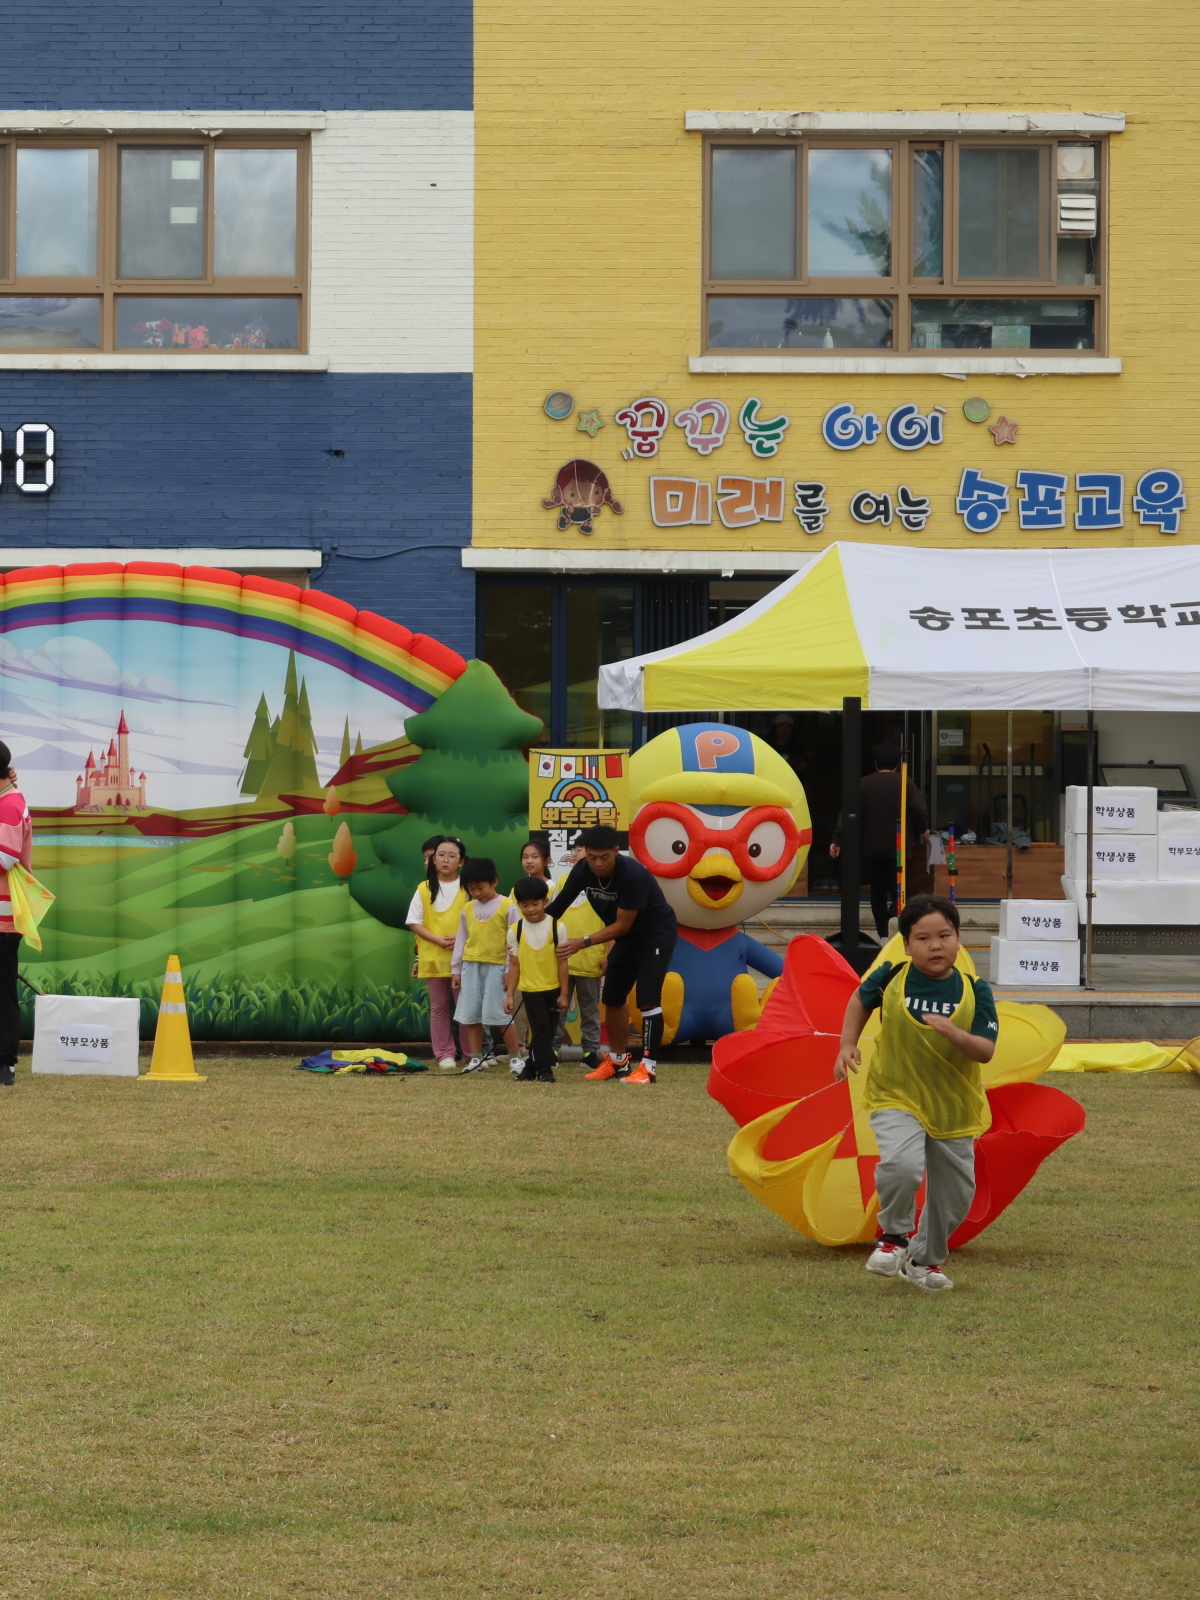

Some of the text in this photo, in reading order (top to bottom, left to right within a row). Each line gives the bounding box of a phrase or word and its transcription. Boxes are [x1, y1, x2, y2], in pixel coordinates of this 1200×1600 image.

[615, 397, 945, 457] 꿈꾸는 아이
[650, 467, 1187, 534] 미래를 여는 송포교육
[694, 730, 740, 769] P
[541, 807, 617, 829] 뽀로로팀
[1095, 806, 1136, 818] 학생상품
[1096, 851, 1137, 863] 학생상품
[1021, 916, 1063, 928] 학생상품
[1019, 960, 1060, 972] 학생상품
[59, 1036, 109, 1049] 학부모상품
